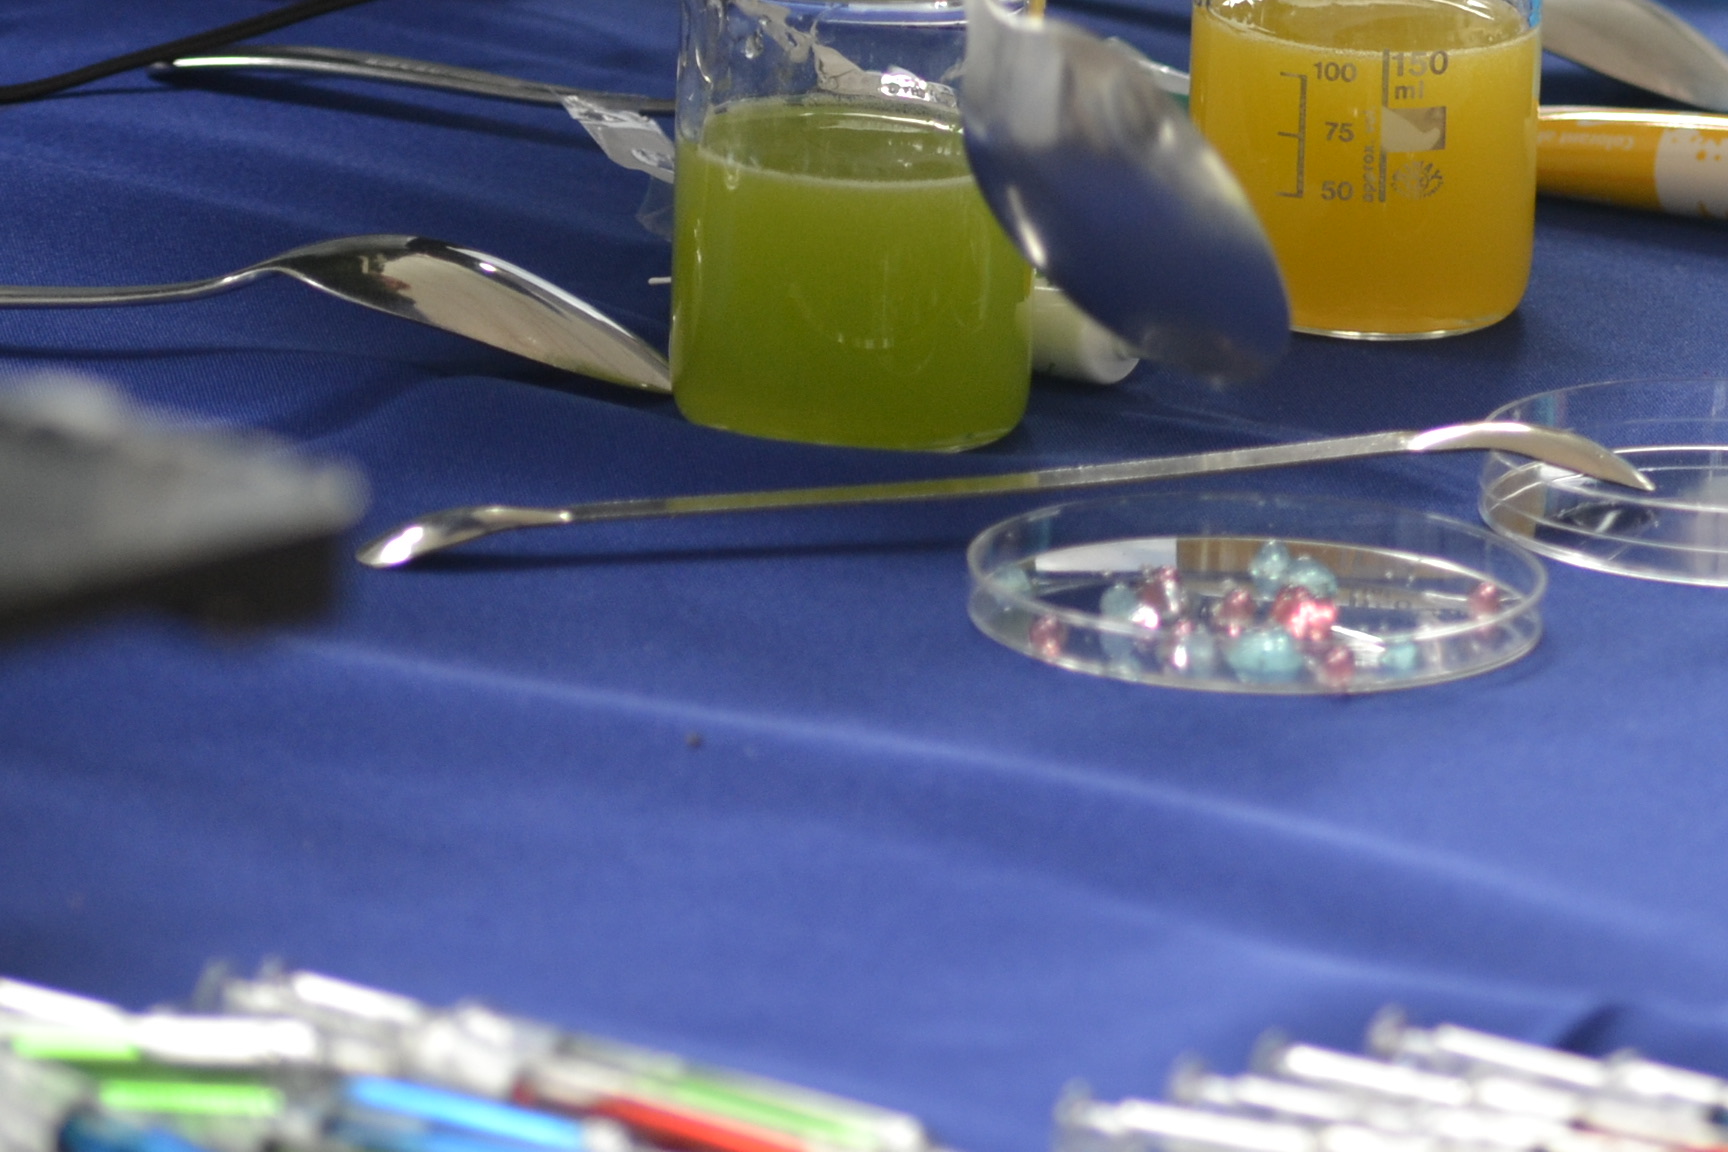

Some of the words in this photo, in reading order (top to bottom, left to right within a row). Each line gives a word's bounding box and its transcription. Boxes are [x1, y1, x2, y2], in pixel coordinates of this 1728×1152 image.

[1313, 61, 1358, 83] 100
[1391, 50, 1449, 77] 150
[1394, 79, 1424, 100] ml
[1325, 121, 1356, 143] 75
[1320, 180, 1354, 202] 50
